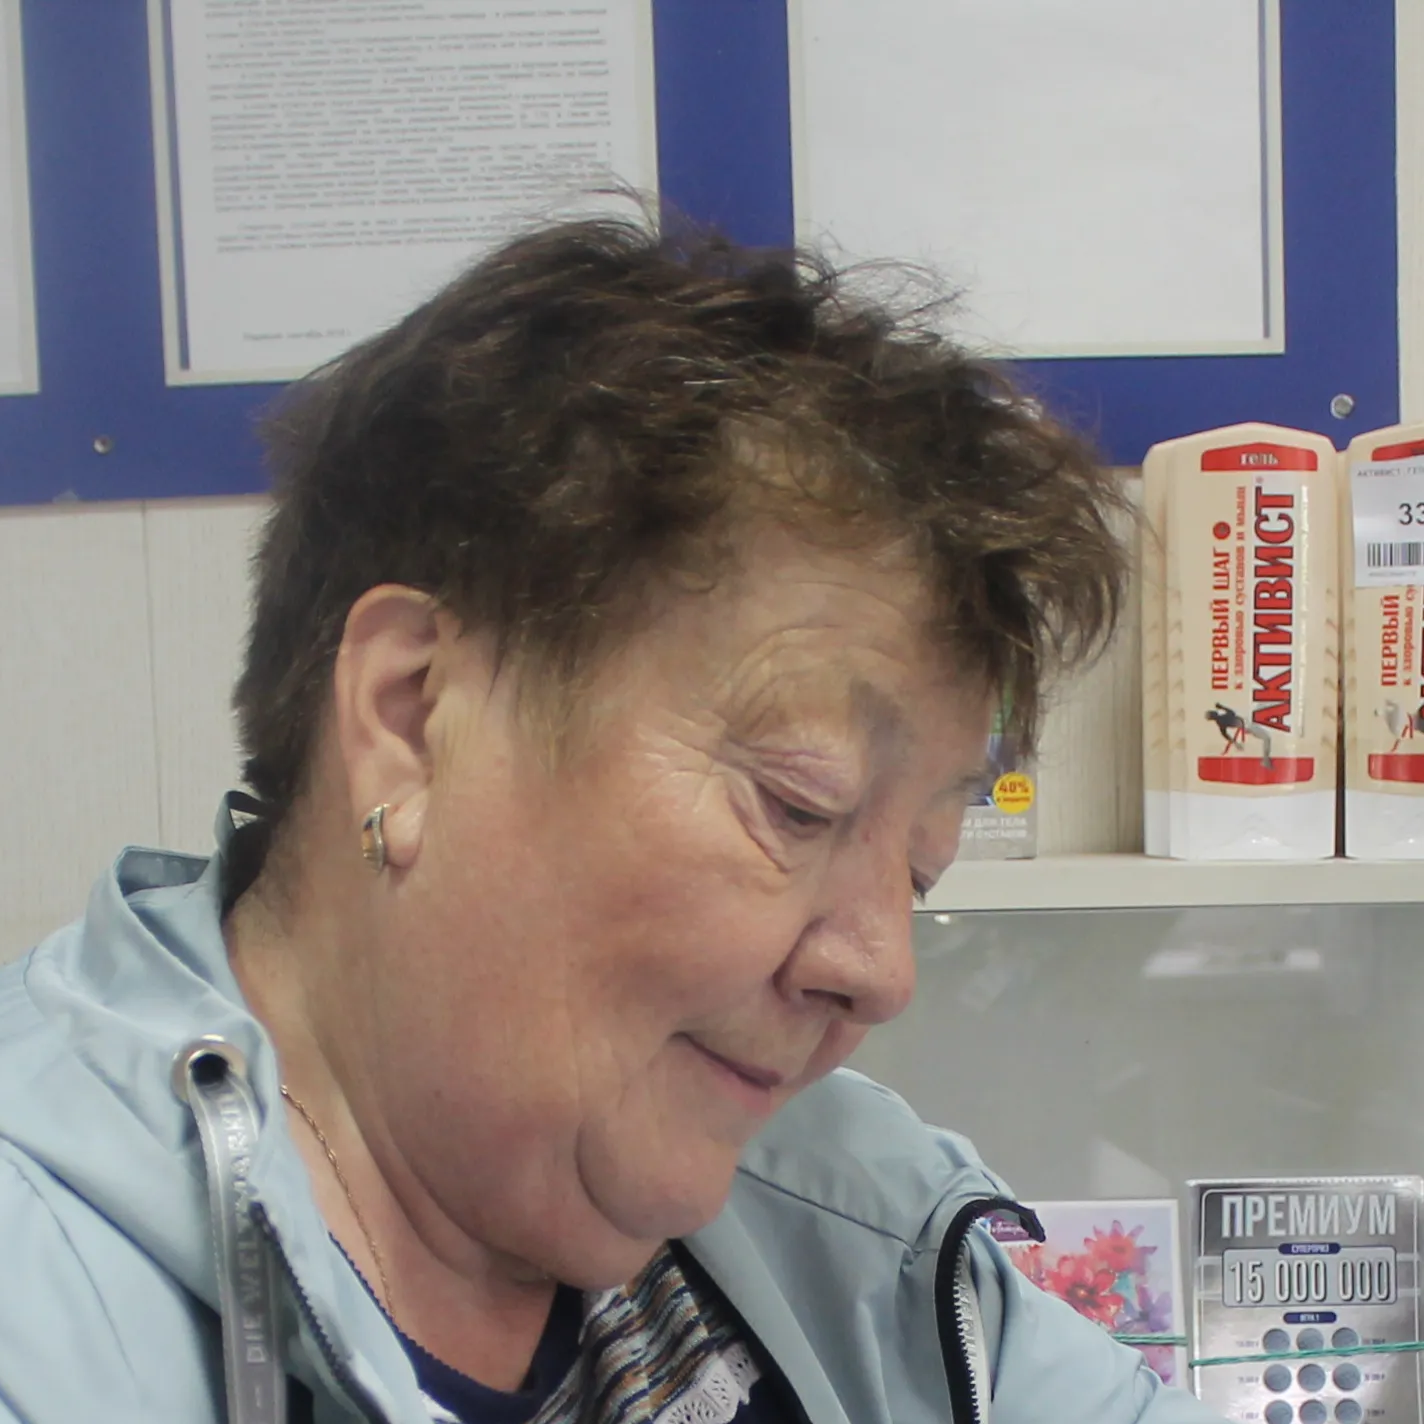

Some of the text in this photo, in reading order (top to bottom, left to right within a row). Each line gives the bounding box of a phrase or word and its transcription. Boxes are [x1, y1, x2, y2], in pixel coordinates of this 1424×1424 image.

[1209, 546, 1231, 691] ПЕРВЫЙ ШАГ
[1252, 485, 1294, 734] АКТИВИСТ
[1379, 594, 1400, 687] ПЕРВЫЙ
[1221, 1193, 1397, 1238] ПРЕМИУМ
[1229, 1258, 1392, 1304] 15 000 000
